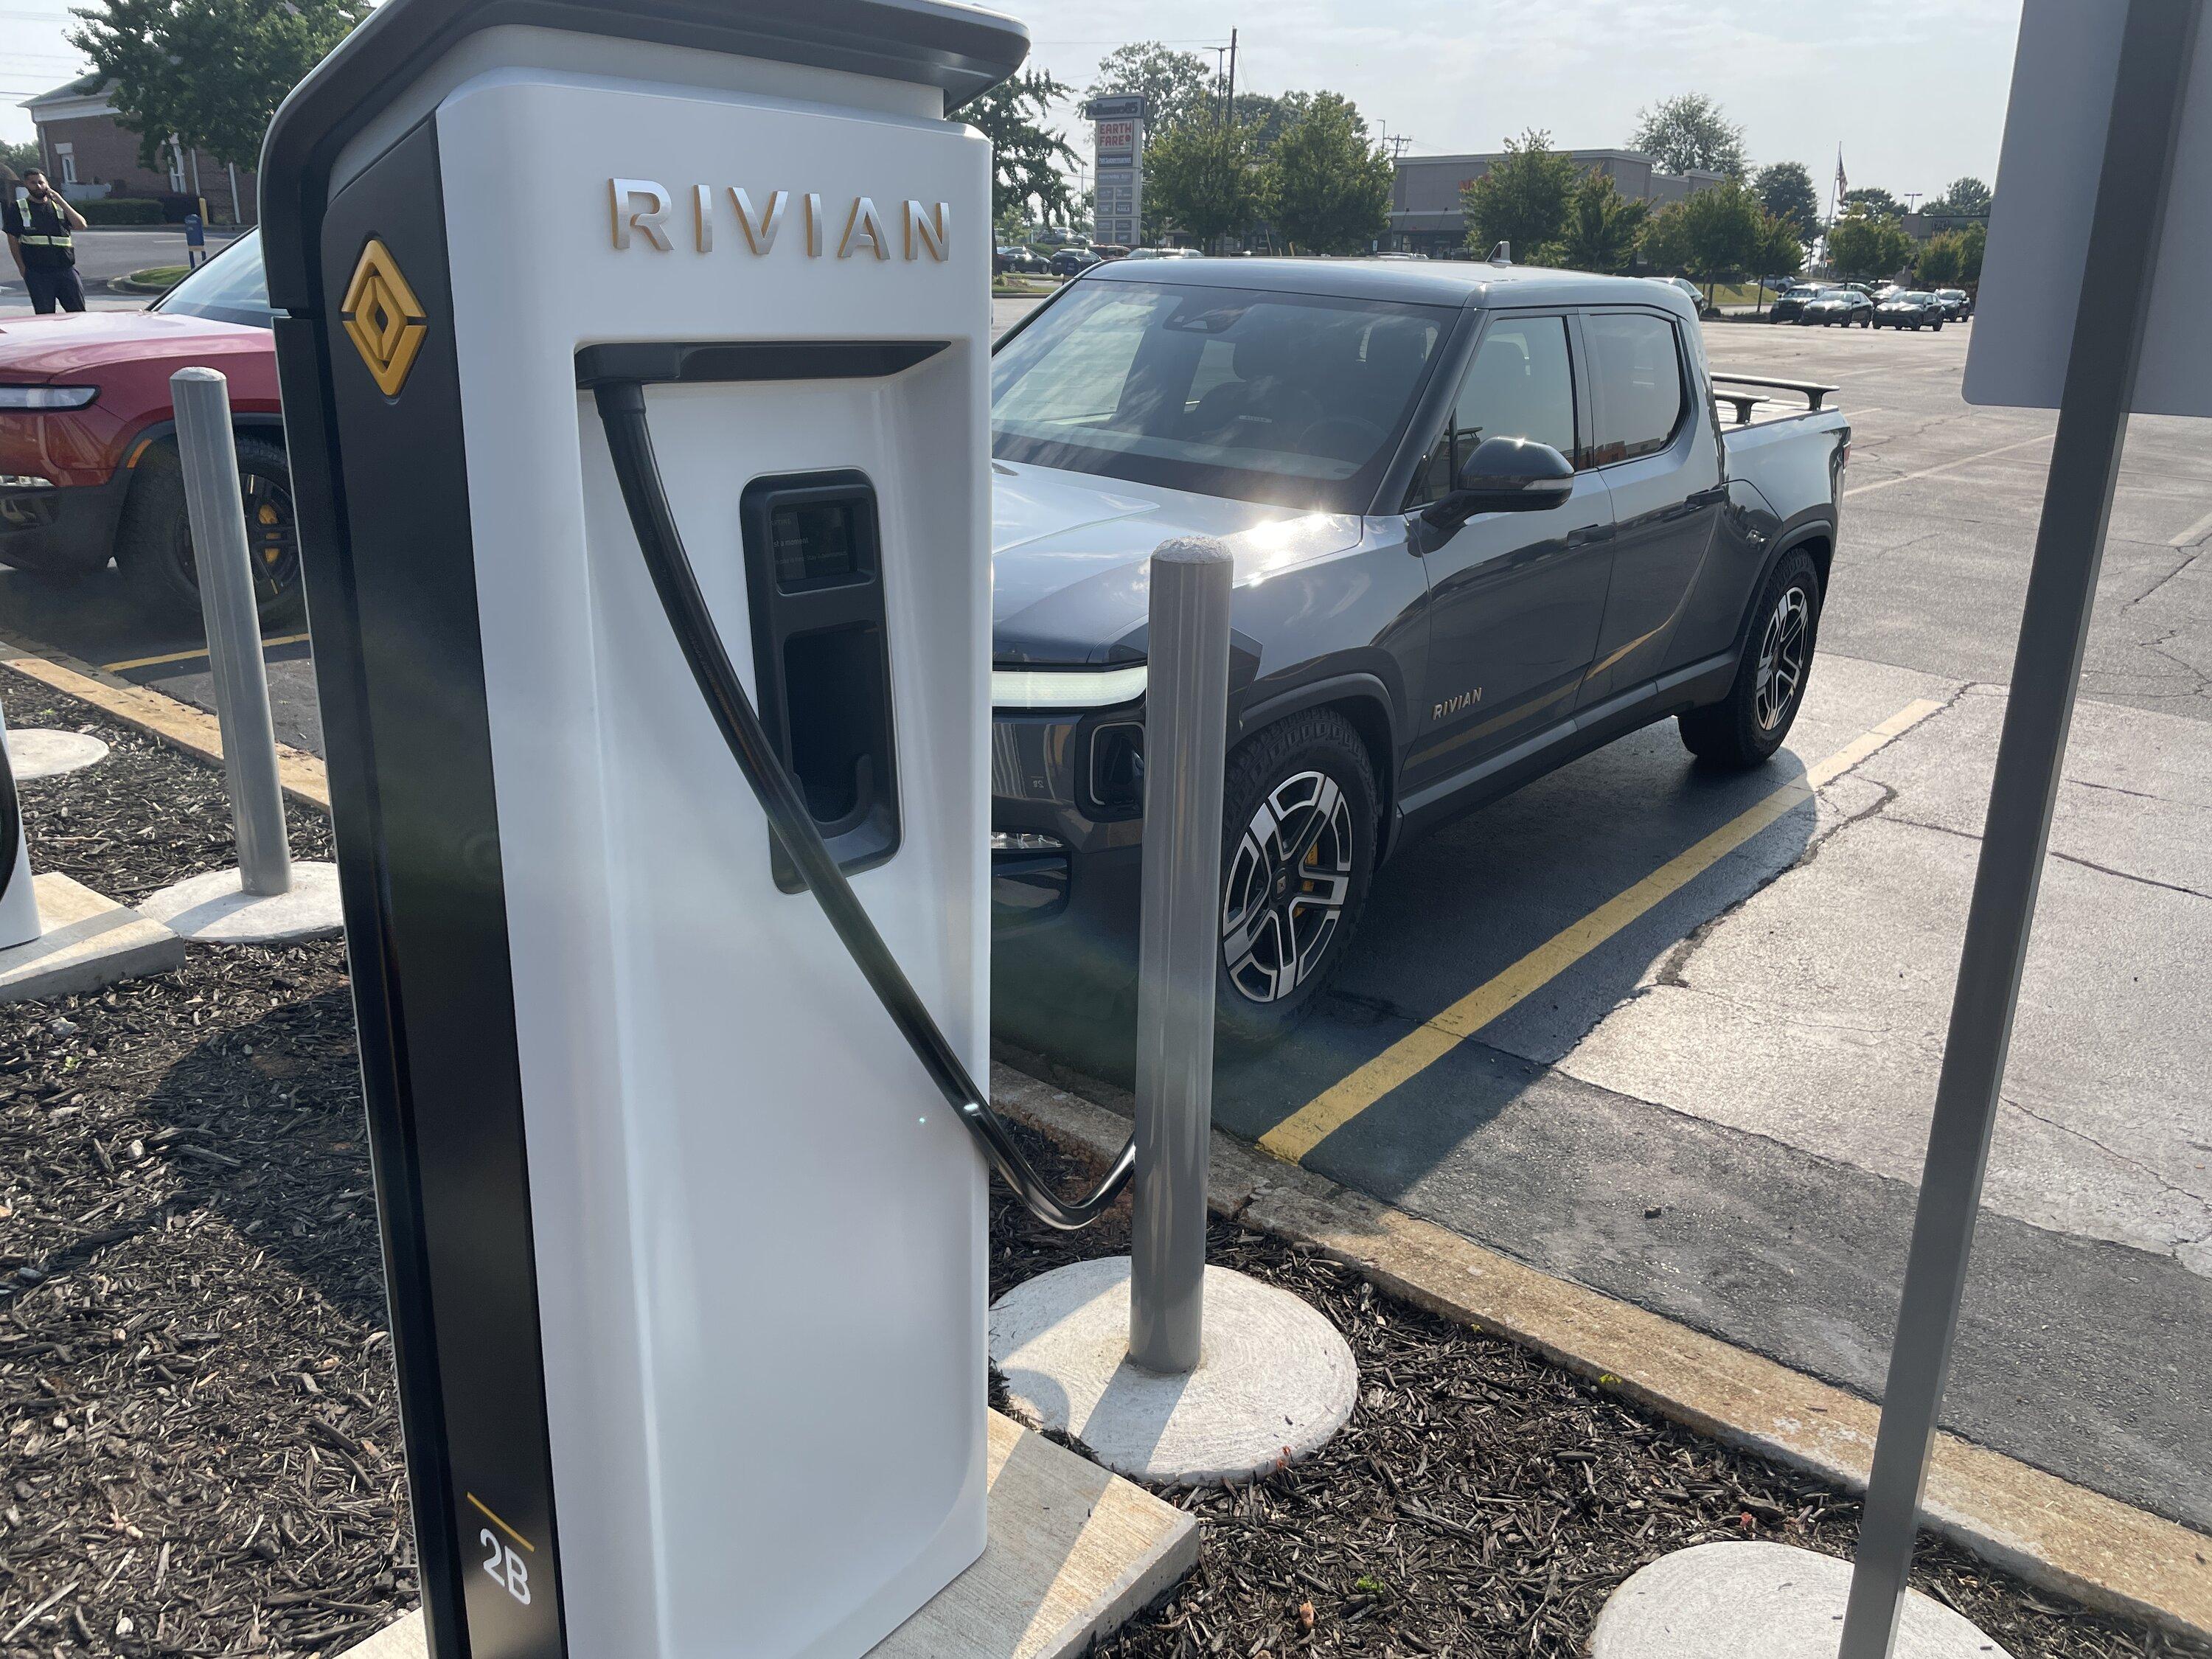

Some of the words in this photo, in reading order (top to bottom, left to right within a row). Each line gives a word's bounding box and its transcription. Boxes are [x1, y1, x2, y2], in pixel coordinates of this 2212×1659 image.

[1099, 122, 1132, 134] EARTH
[1099, 135, 1124, 147] FARE
[608, 178, 950, 261] RIVIAN
[785, 537, 809, 546] moment
[1433, 686, 1482, 720] RIVIAN
[480, 1528, 531, 1605] 2B
